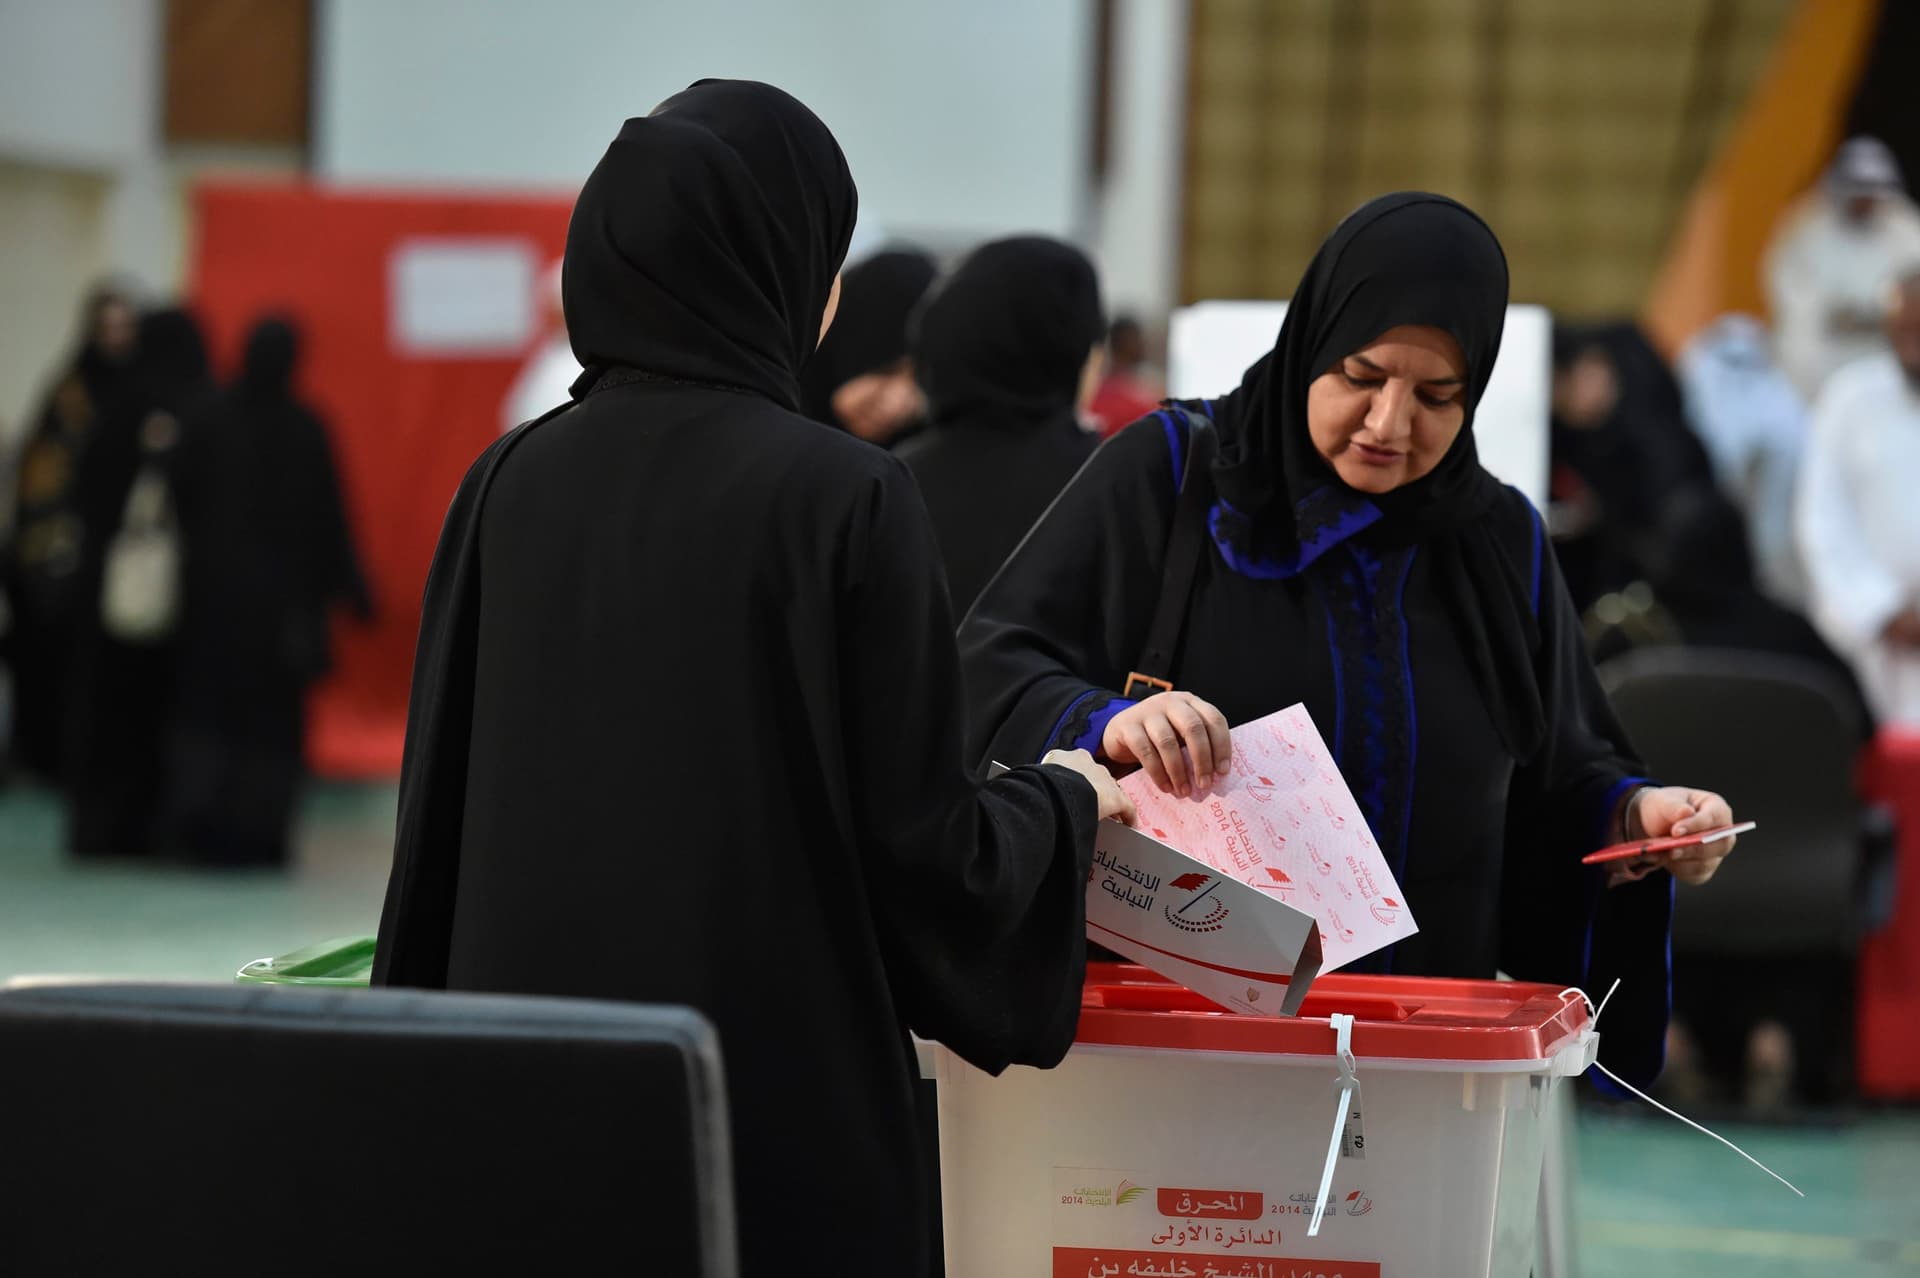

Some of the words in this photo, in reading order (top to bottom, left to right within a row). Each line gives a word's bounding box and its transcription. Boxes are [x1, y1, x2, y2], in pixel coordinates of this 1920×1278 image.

[1210, 801, 1231, 832] 2014
[1229, 809, 1263, 866] الانتخابات
[1101, 875, 1154, 911] النيابية
[1061, 1195, 1083, 1204] 2014
[1176, 1193, 1244, 1214] المحرق
[1271, 1204, 1300, 1214] 2014
[1151, 1220, 1209, 1246] الأولى
[1215, 1227, 1282, 1248] الدائرة
